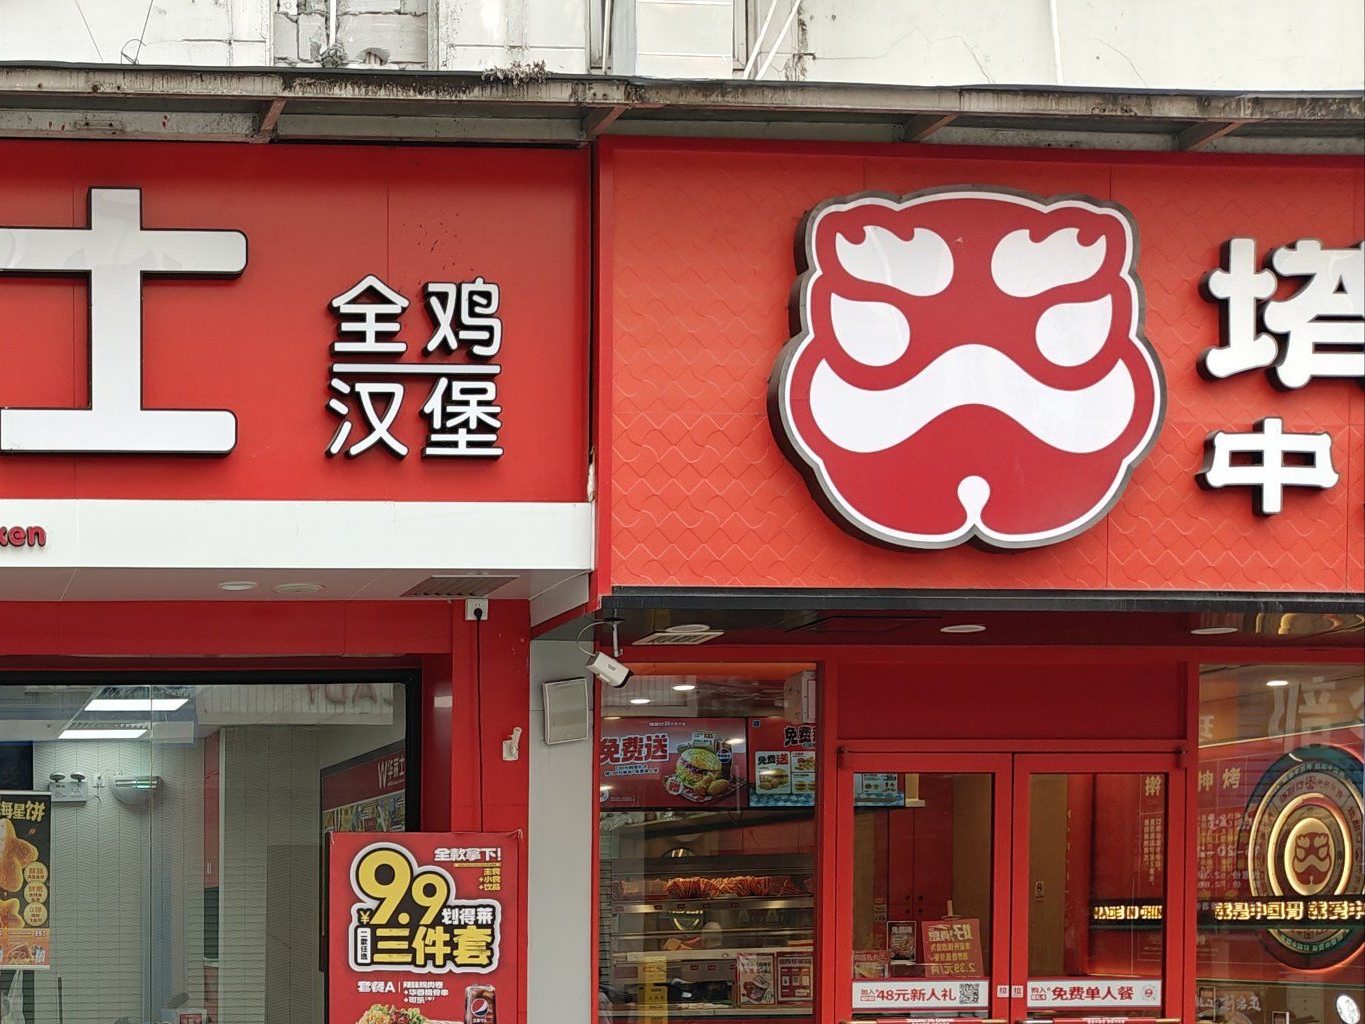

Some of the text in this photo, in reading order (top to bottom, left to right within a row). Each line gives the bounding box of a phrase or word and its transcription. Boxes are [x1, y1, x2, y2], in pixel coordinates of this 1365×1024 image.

[328, 274, 503, 358] 全鸡
[325, 376, 504, 457] 汉堡
[1197, 416, 1341, 515] 中
[601, 733, 669, 764] 免费送
[441, 907, 494, 925] 划得莱
[373, 925, 494, 966] 三件套
[876, 988, 957, 1002] 48元新人礼
[1051, 985, 1134, 1001] 免费单人餐
